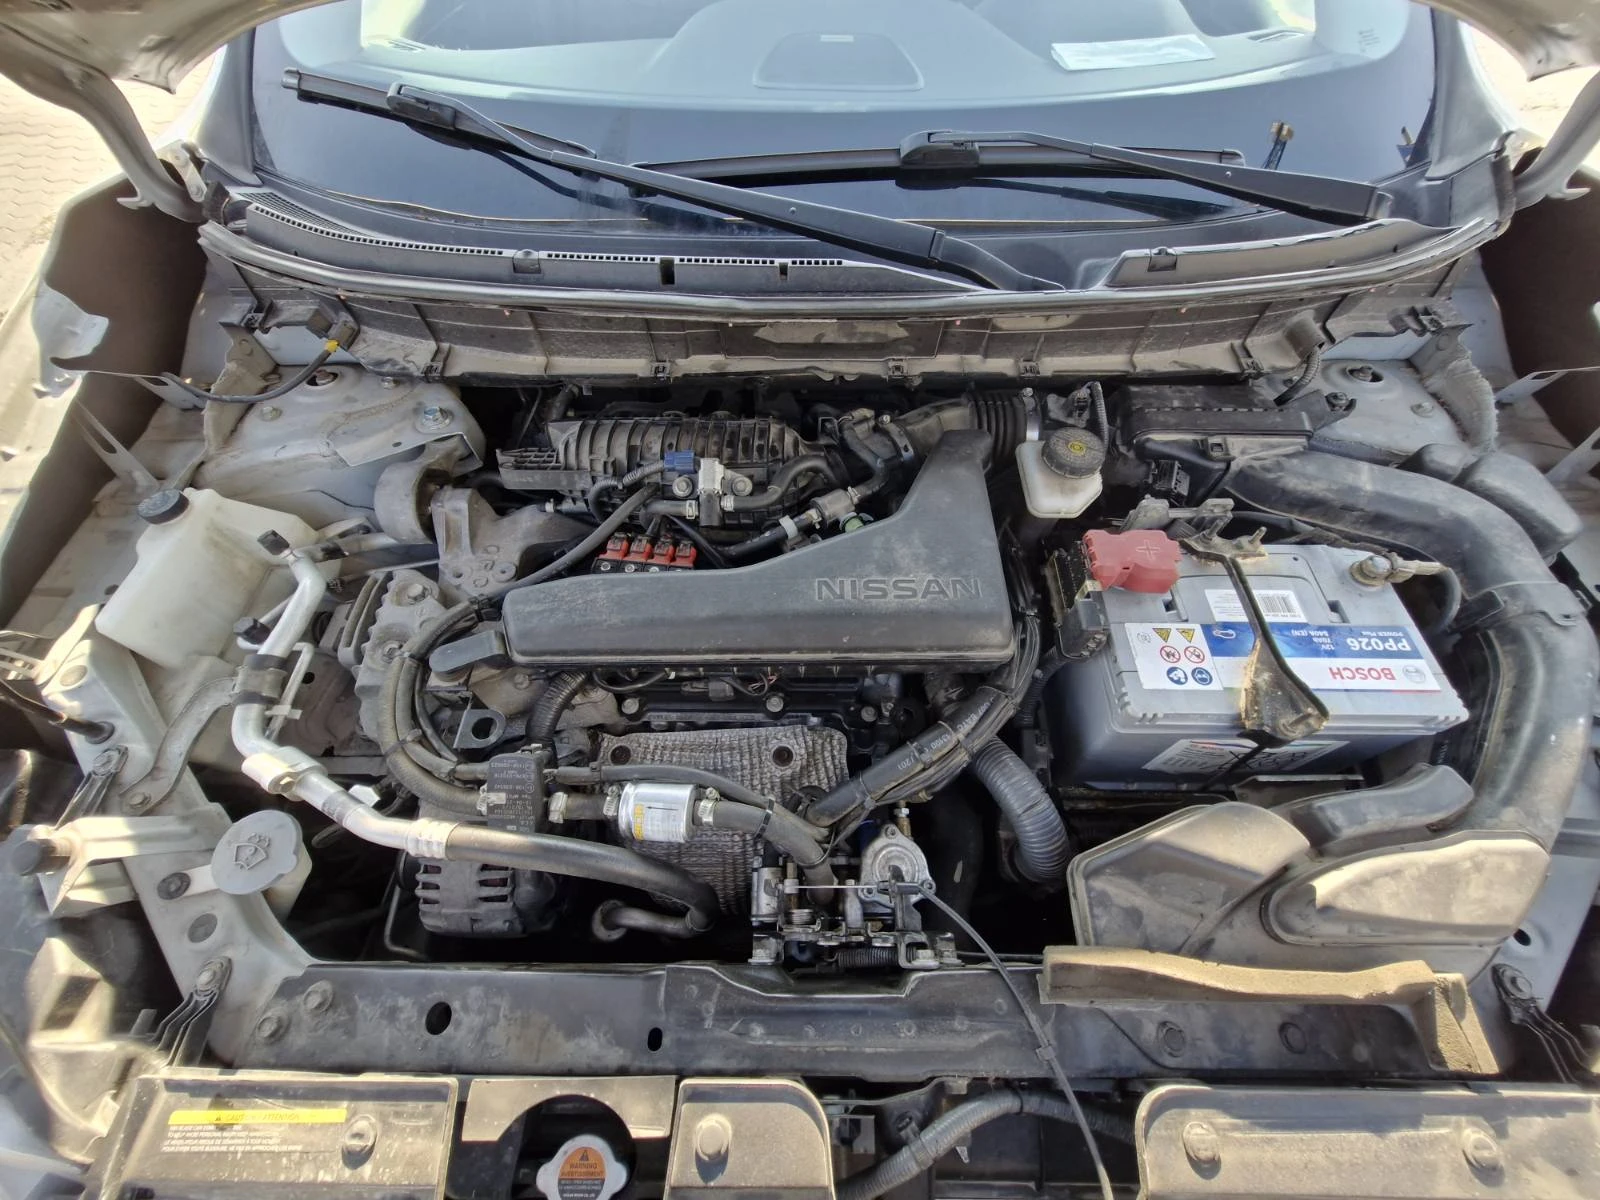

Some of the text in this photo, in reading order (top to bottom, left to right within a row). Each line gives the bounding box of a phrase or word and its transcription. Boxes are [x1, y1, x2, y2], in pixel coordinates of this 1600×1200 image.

[815, 577, 983, 601] NISSAN
[1346, 637, 1412, 651] PP026
[1328, 666, 1397, 681] BOSCH
